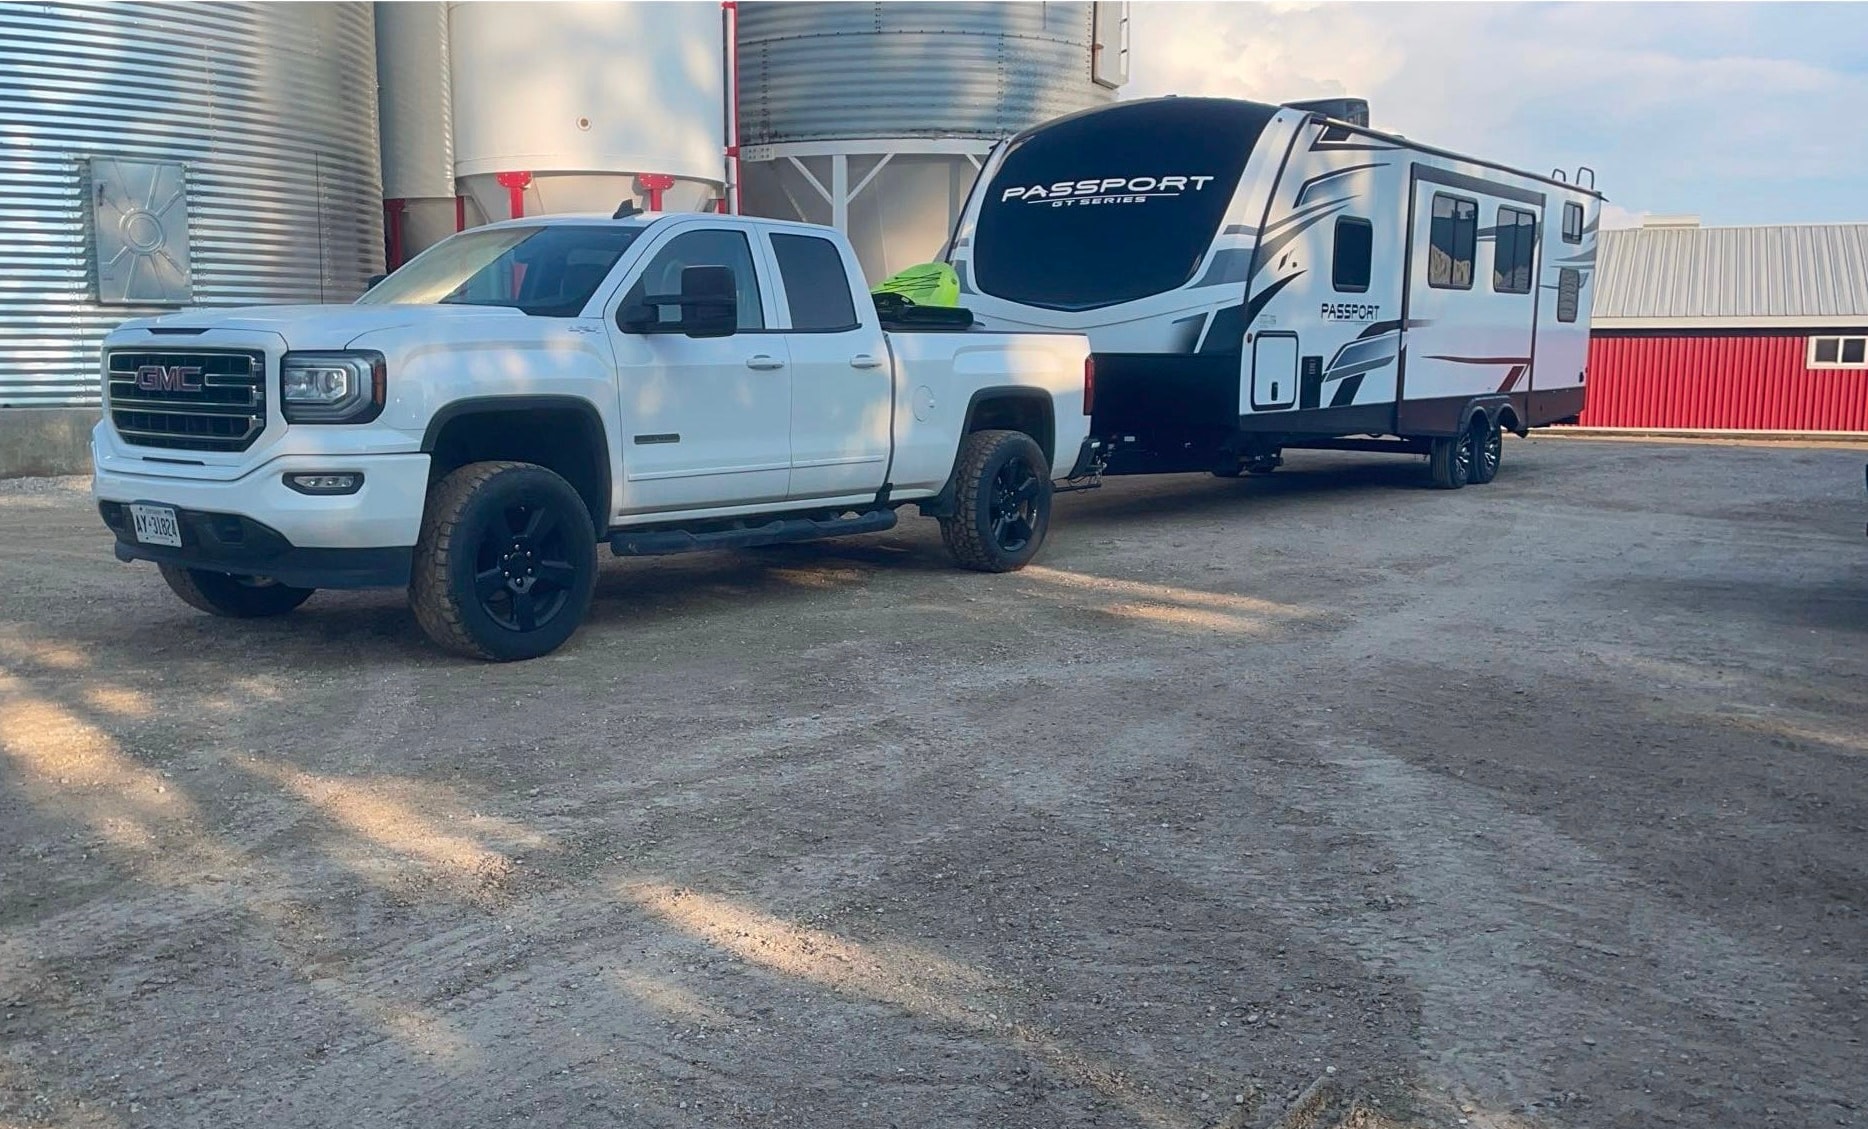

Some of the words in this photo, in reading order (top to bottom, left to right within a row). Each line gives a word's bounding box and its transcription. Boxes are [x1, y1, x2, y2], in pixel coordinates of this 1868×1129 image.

[1002, 176, 1214, 202] PASSPORT
[1051, 199, 1075, 208] GT
[1079, 196, 1147, 206] SERIES
[1321, 303, 1380, 320] PASSPORT
[138, 365, 202, 392] GMC
